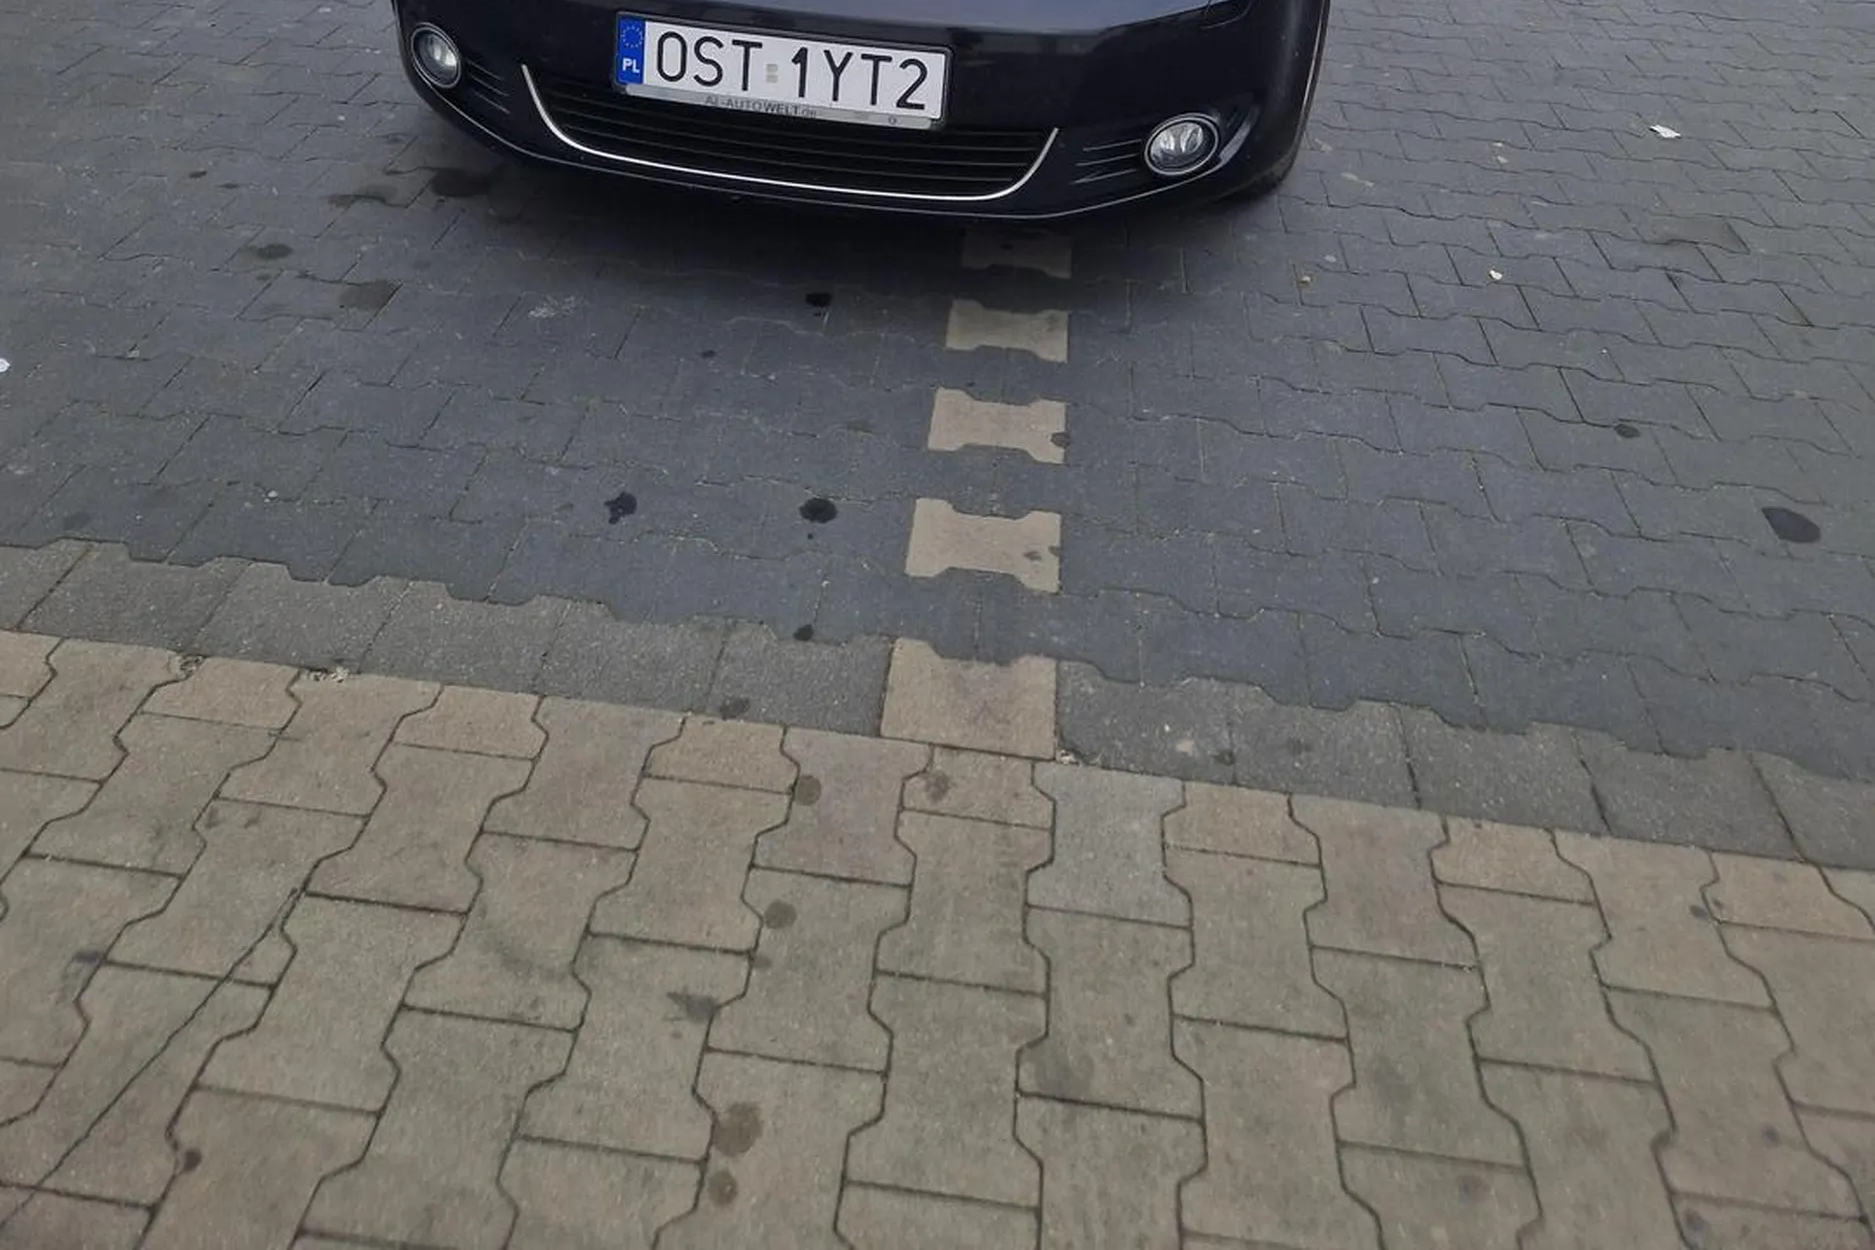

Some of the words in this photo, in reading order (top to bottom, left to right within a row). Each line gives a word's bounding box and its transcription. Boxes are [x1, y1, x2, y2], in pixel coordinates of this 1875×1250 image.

[622, 57, 640, 74] PL
[656, 31, 763, 91] OST
[791, 46, 929, 111] 1YT2
